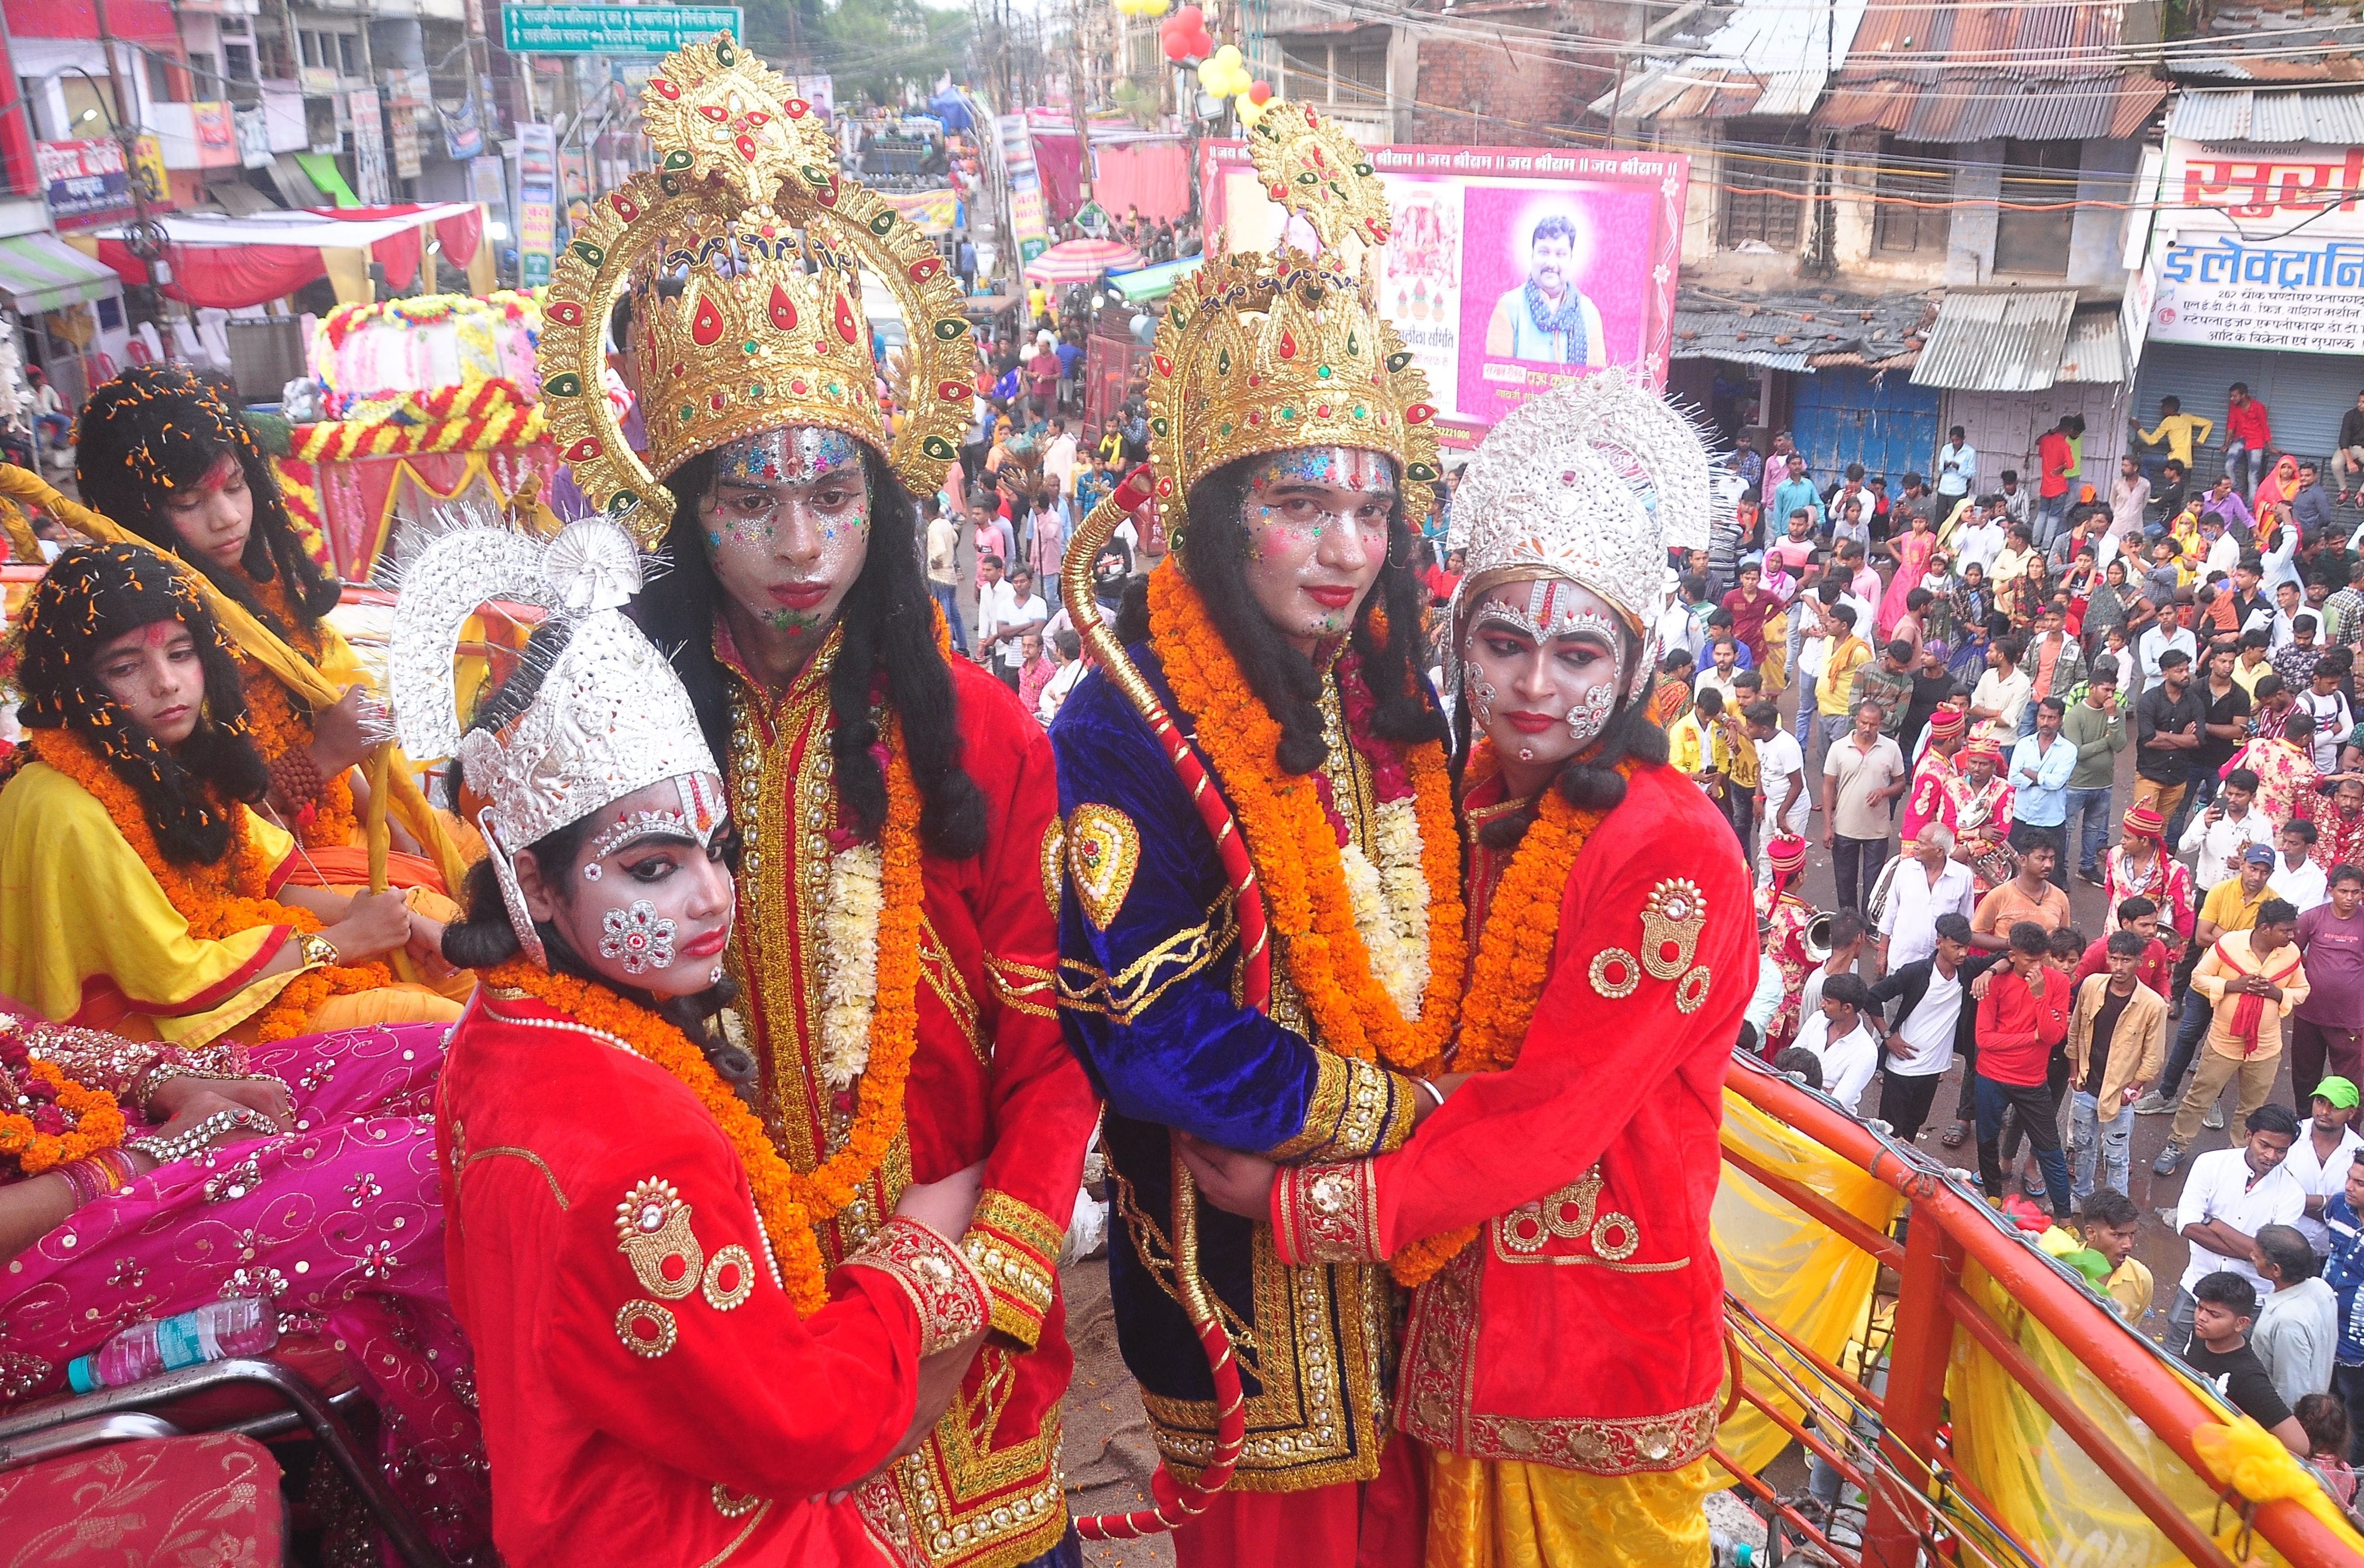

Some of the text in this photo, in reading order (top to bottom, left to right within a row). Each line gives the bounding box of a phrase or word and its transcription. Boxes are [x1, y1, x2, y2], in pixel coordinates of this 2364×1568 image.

[1427, 154, 1451, 168] जय
[1454, 150, 1492, 169] श्रीराम
[1507, 156, 1532, 171] जय
[1534, 153, 1575, 172] श्रीराम
[1591, 160, 1617, 174] जय
[1620, 156, 1663, 176] श्रीराम
[1428, 326, 1454, 348] समिति
